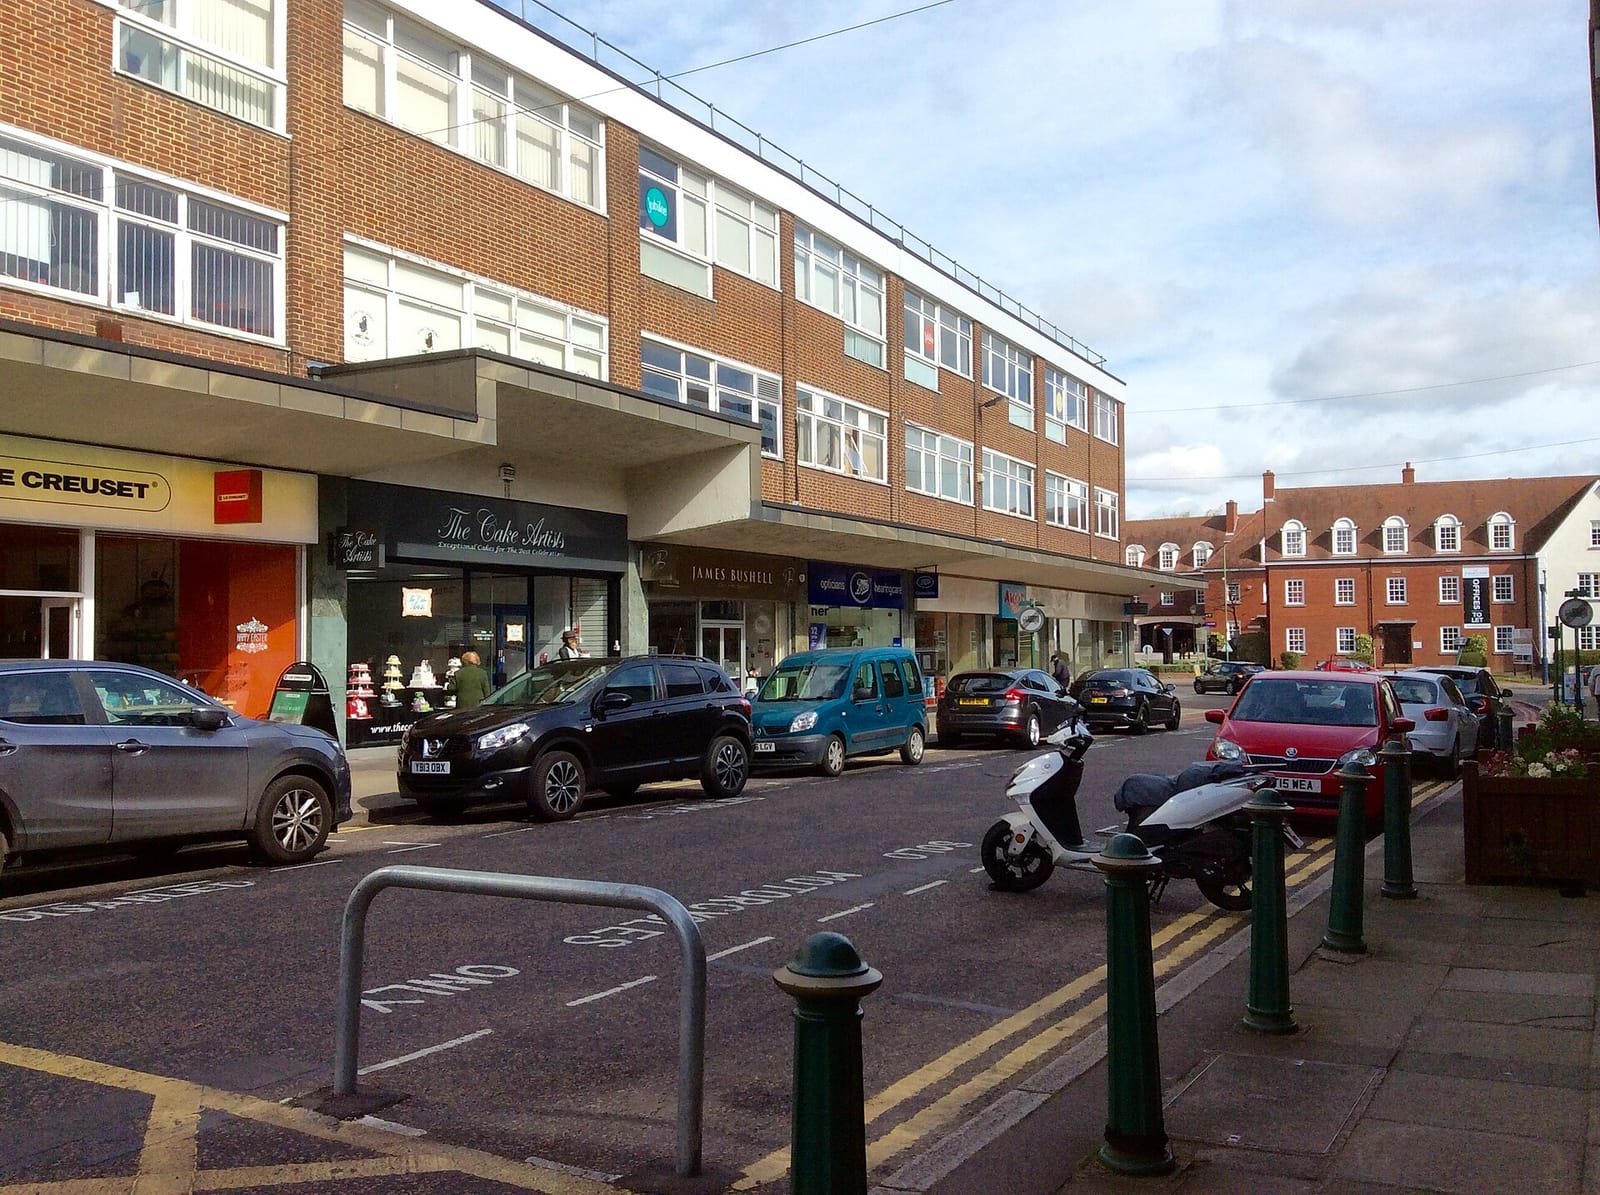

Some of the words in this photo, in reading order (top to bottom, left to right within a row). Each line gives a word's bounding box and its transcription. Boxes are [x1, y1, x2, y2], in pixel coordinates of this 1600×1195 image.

[22, 471, 149, 499] CREUSET
[339, 533, 354, 548] The
[355, 531, 377, 547] Cake
[438, 507, 471, 540] The
[477, 508, 520, 543] Cake
[522, 517, 565, 549] Artists
[343, 545, 372, 563] Artists
[692, 566, 726, 581] JAMES
[731, 569, 773, 584] BUSHELL
[1472, 579, 1480, 610] OFFICES
[1292, 779, 1313, 791] WEA
[882, 839, 973, 860] SOLO
[0, 881, 256, 922] DISABLED
[563, 870, 863, 948] MOTORCYLES
[361, 965, 521, 1014] ONLY
